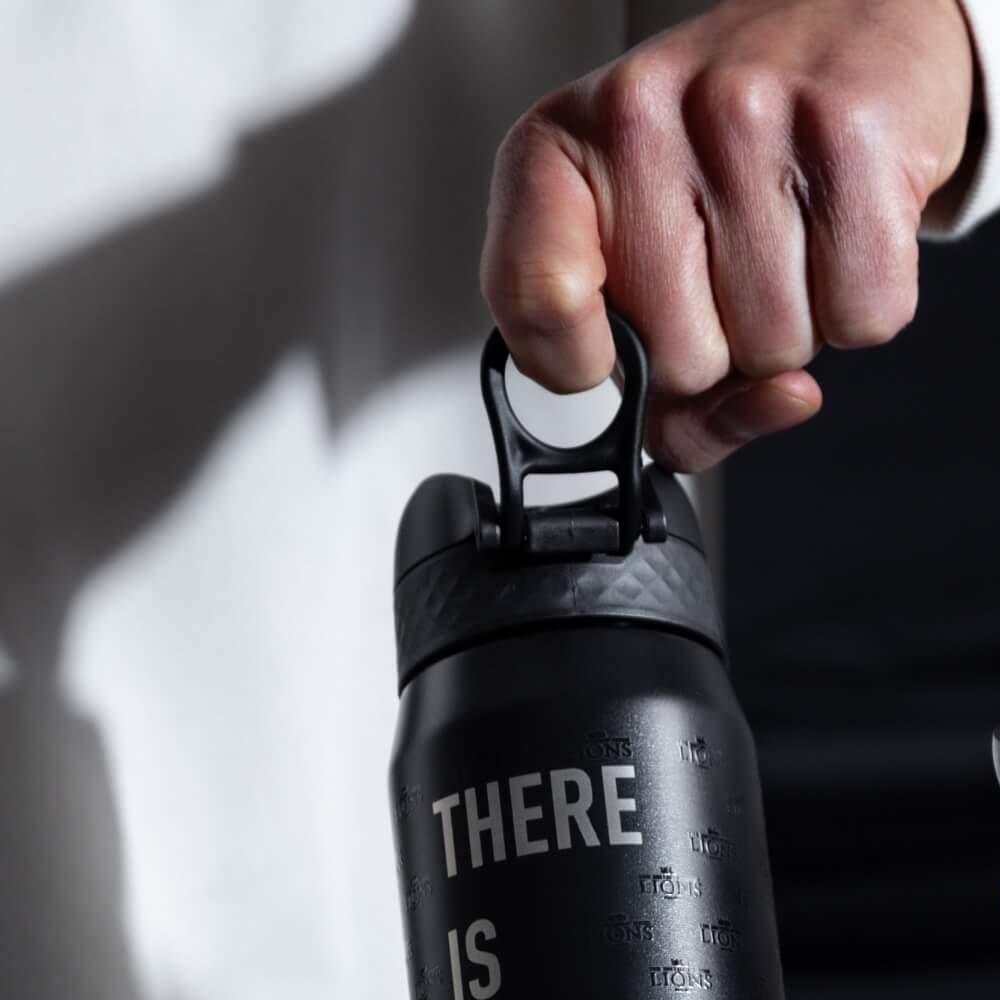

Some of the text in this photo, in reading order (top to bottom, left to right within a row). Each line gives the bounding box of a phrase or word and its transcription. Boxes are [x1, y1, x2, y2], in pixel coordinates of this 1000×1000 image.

[432, 765, 643, 878] THERE
[640, 878, 703, 897] LIONS
[651, 971, 713, 990] LIONS
